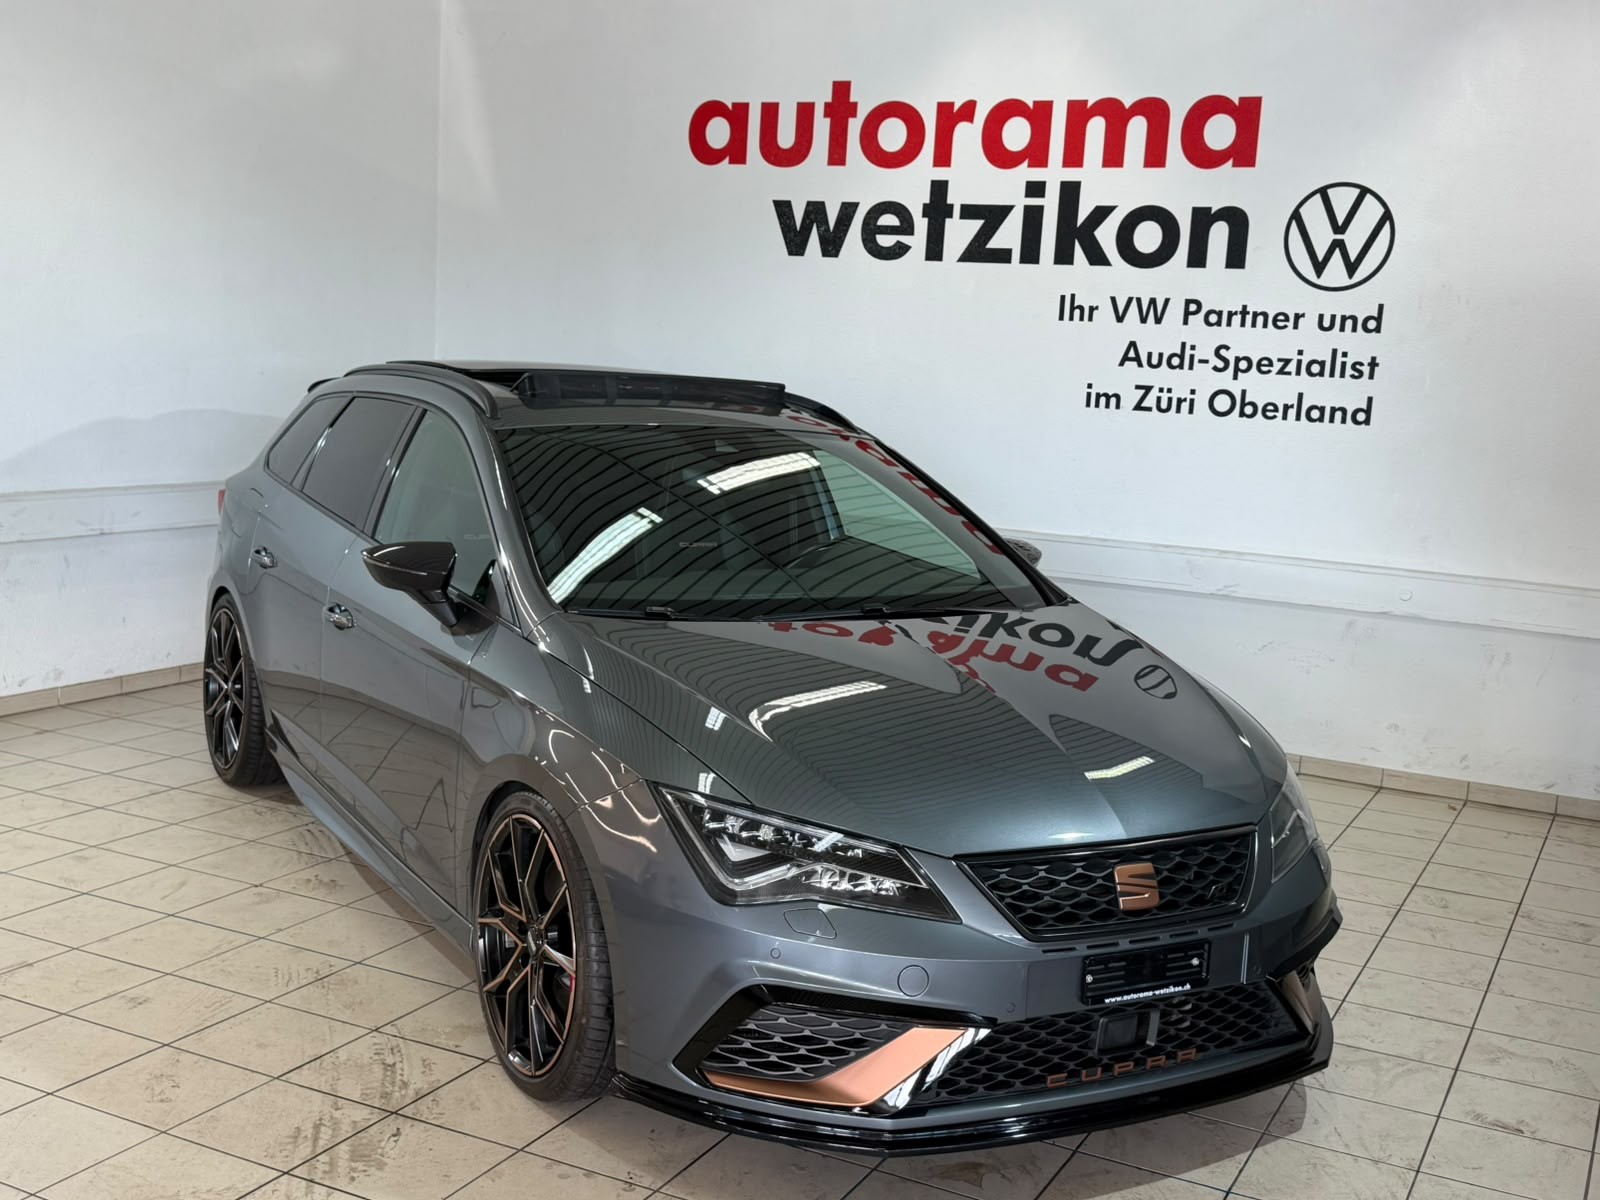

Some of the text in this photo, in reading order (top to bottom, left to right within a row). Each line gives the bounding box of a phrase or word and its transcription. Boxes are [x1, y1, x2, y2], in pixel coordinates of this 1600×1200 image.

[688, 80, 1263, 171] autorama
[772, 179, 1250, 270] wetzikon
[1058, 293, 1385, 334] Ihr VW Partner und
[1117, 341, 1380, 381] Audi-Spezialist
[1085, 382, 1374, 426] im Züri Oberland
[1046, 1048, 1197, 1089] CUPRA
